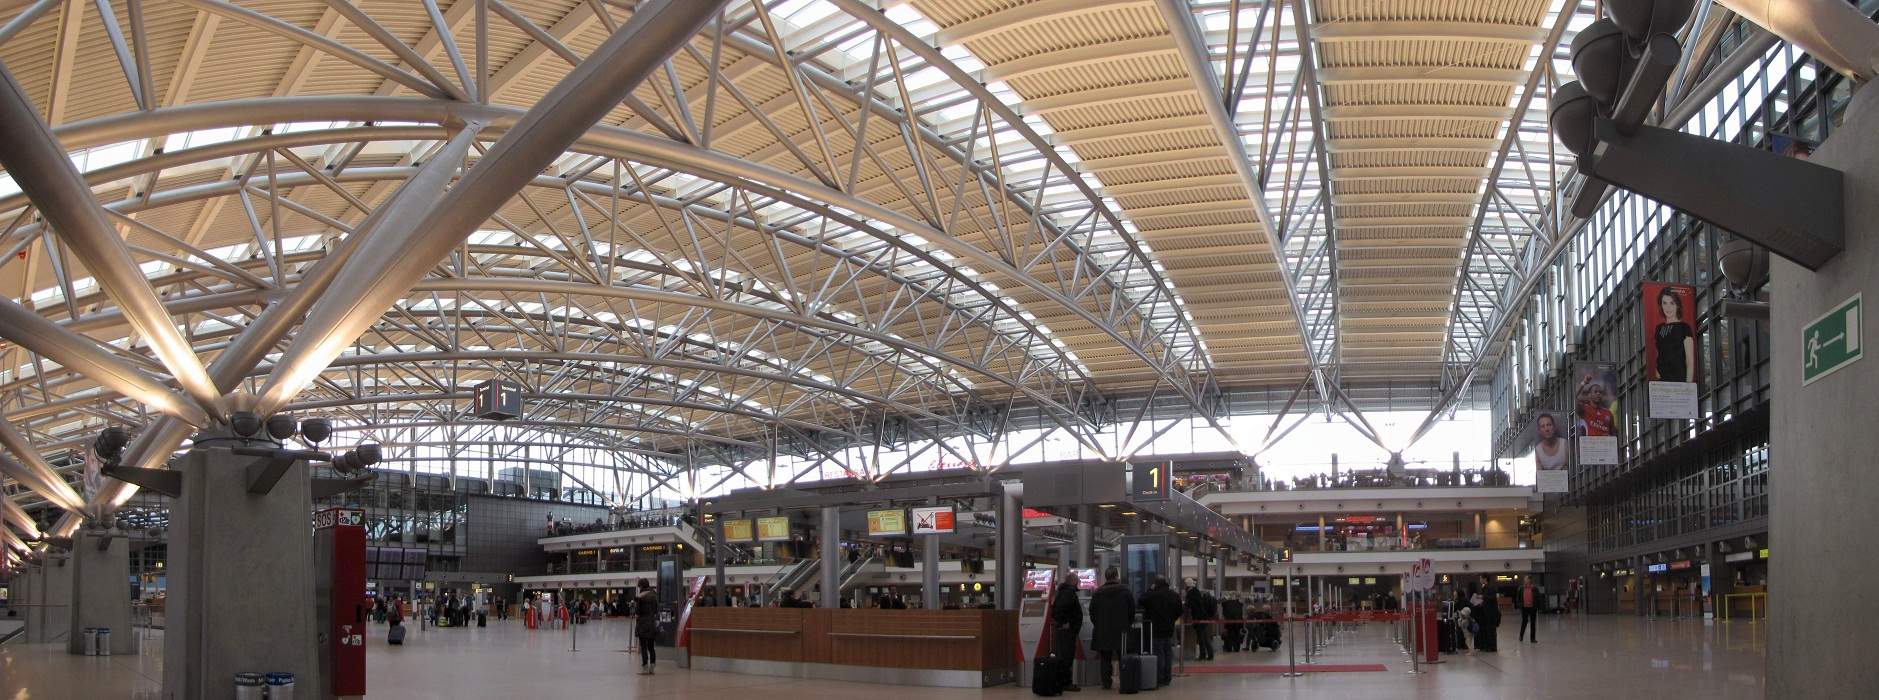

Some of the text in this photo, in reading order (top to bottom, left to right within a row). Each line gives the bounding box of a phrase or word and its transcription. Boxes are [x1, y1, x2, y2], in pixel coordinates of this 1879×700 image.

[479, 393, 484, 408] 1
[501, 392, 506, 407] 1
[1149, 467, 1159, 488] 1
[316, 513, 332, 527] SOS
[1283, 549, 1289, 558] 1
